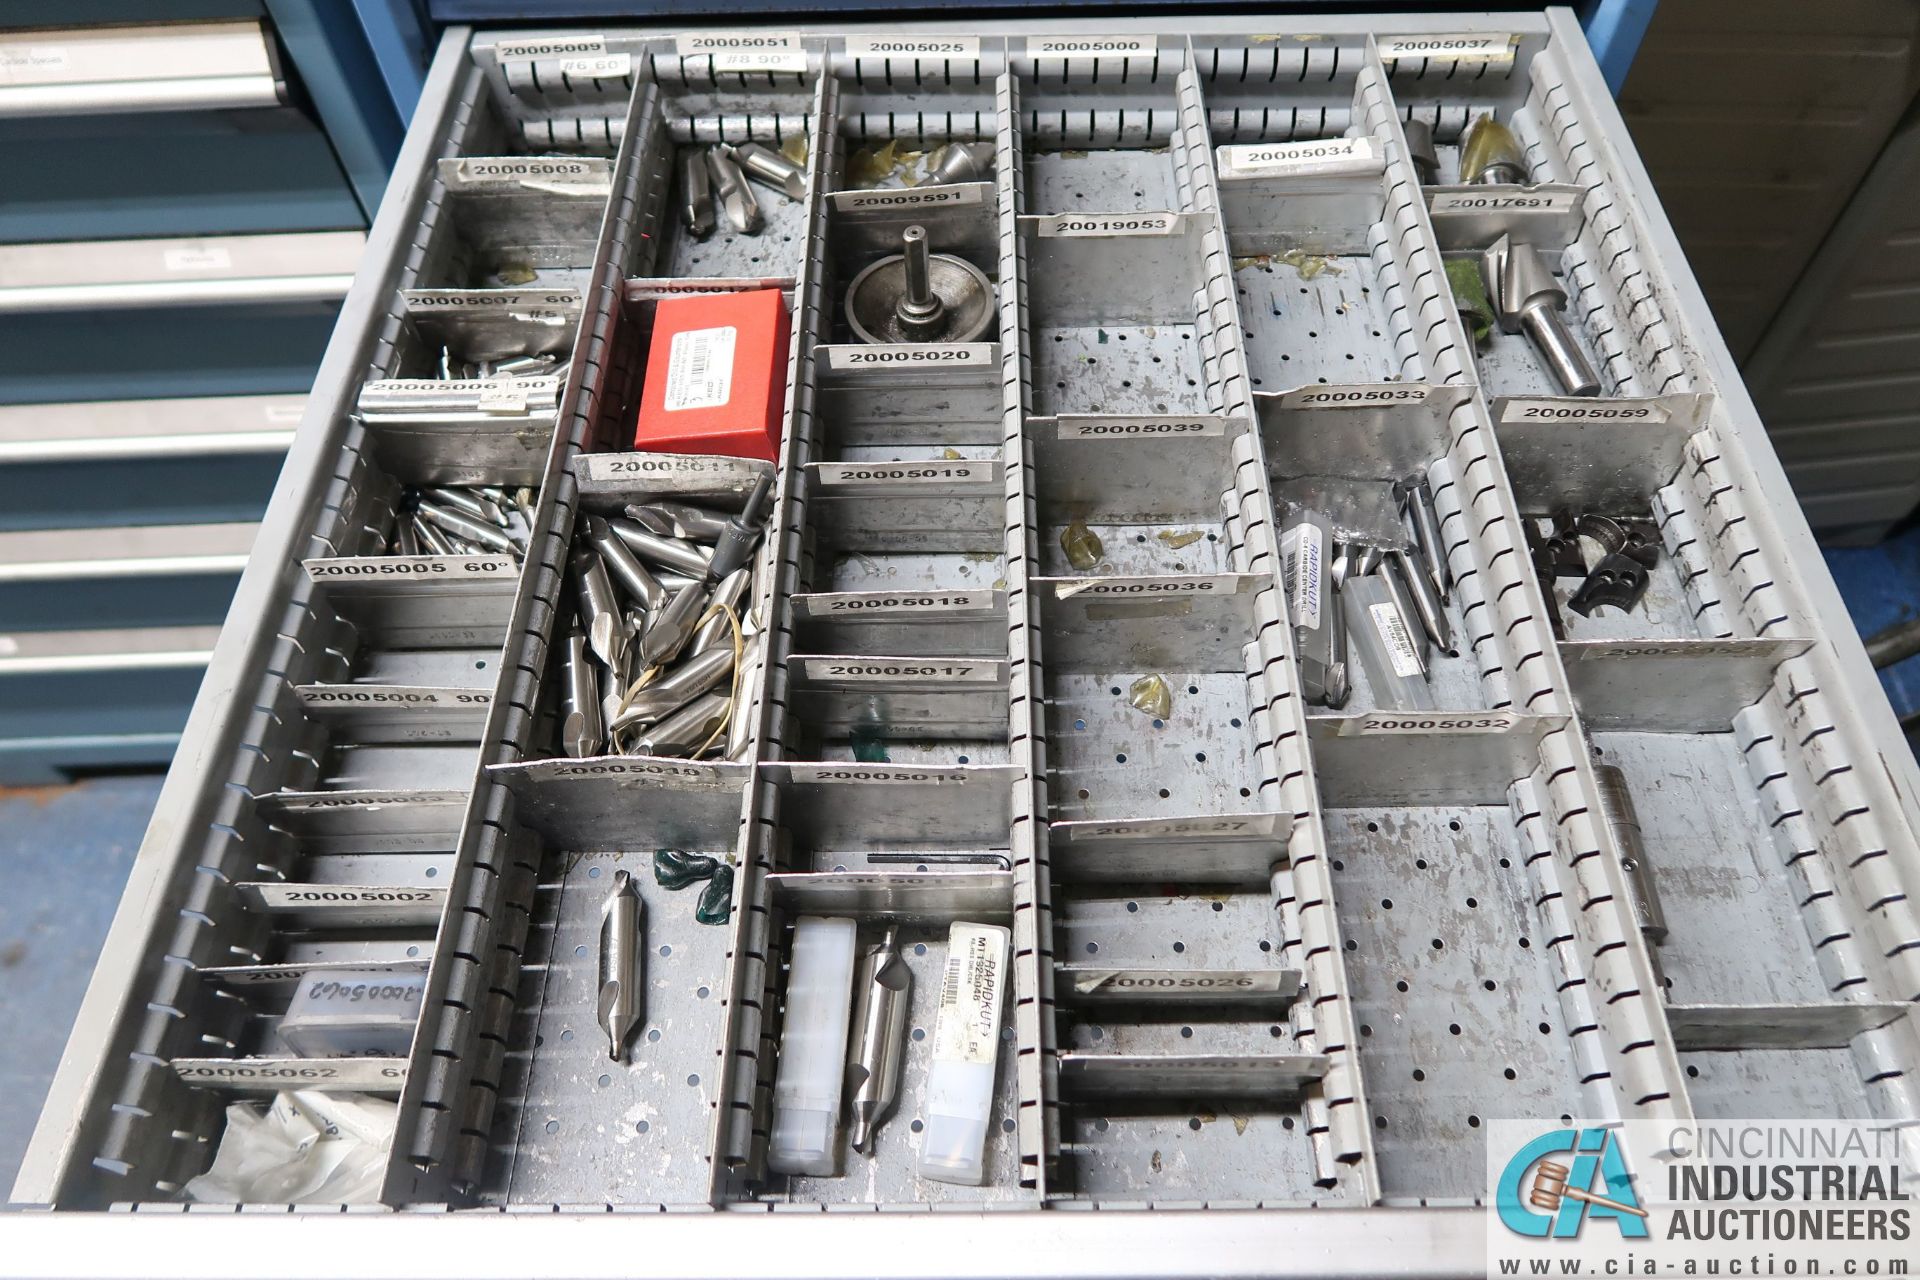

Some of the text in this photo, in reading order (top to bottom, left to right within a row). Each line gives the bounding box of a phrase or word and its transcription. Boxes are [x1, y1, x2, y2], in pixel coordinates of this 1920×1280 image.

[691, 37, 789, 49] 20005051
[870, 42, 964, 54] 20005025
[1042, 40, 1141, 52] 20005000
[1393, 39, 1493, 52] 20005037
[503, 42, 601, 57] 20005009
[725, 51, 791, 65] #8 90°
[1248, 145, 1354, 162] 20005034
[474, 163, 583, 175] 20005008
[852, 191, 962, 207] 20009591
[1449, 197, 1554, 209] 20017691
[1056, 219, 1167, 232] 20019053
[408, 295, 521, 307] 20005007
[850, 350, 971, 363] 20005020
[373, 382, 498, 392] 20005006
[1301, 390, 1426, 403] 20005033
[1523, 407, 1649, 418] 20005059
[1079, 424, 1204, 435] 20005039
[841, 469, 971, 480] 20005019
[309, 561, 508, 576] 20005005 60°
[1308, 543, 1320, 613] RAPIDKUT
[831, 597, 970, 610] 20005018
[830, 666, 974, 676] 20005017
[302, 692, 439, 703] 20005004
[1363, 719, 1511, 730] 20005032
[816, 771, 968, 781] 20005016
[286, 892, 433, 902] 20005002
[1099, 978, 1253, 987] 20005026
[980, 958, 997, 1029] RAPIDKUT
[178, 1067, 340, 1079] 20005062
